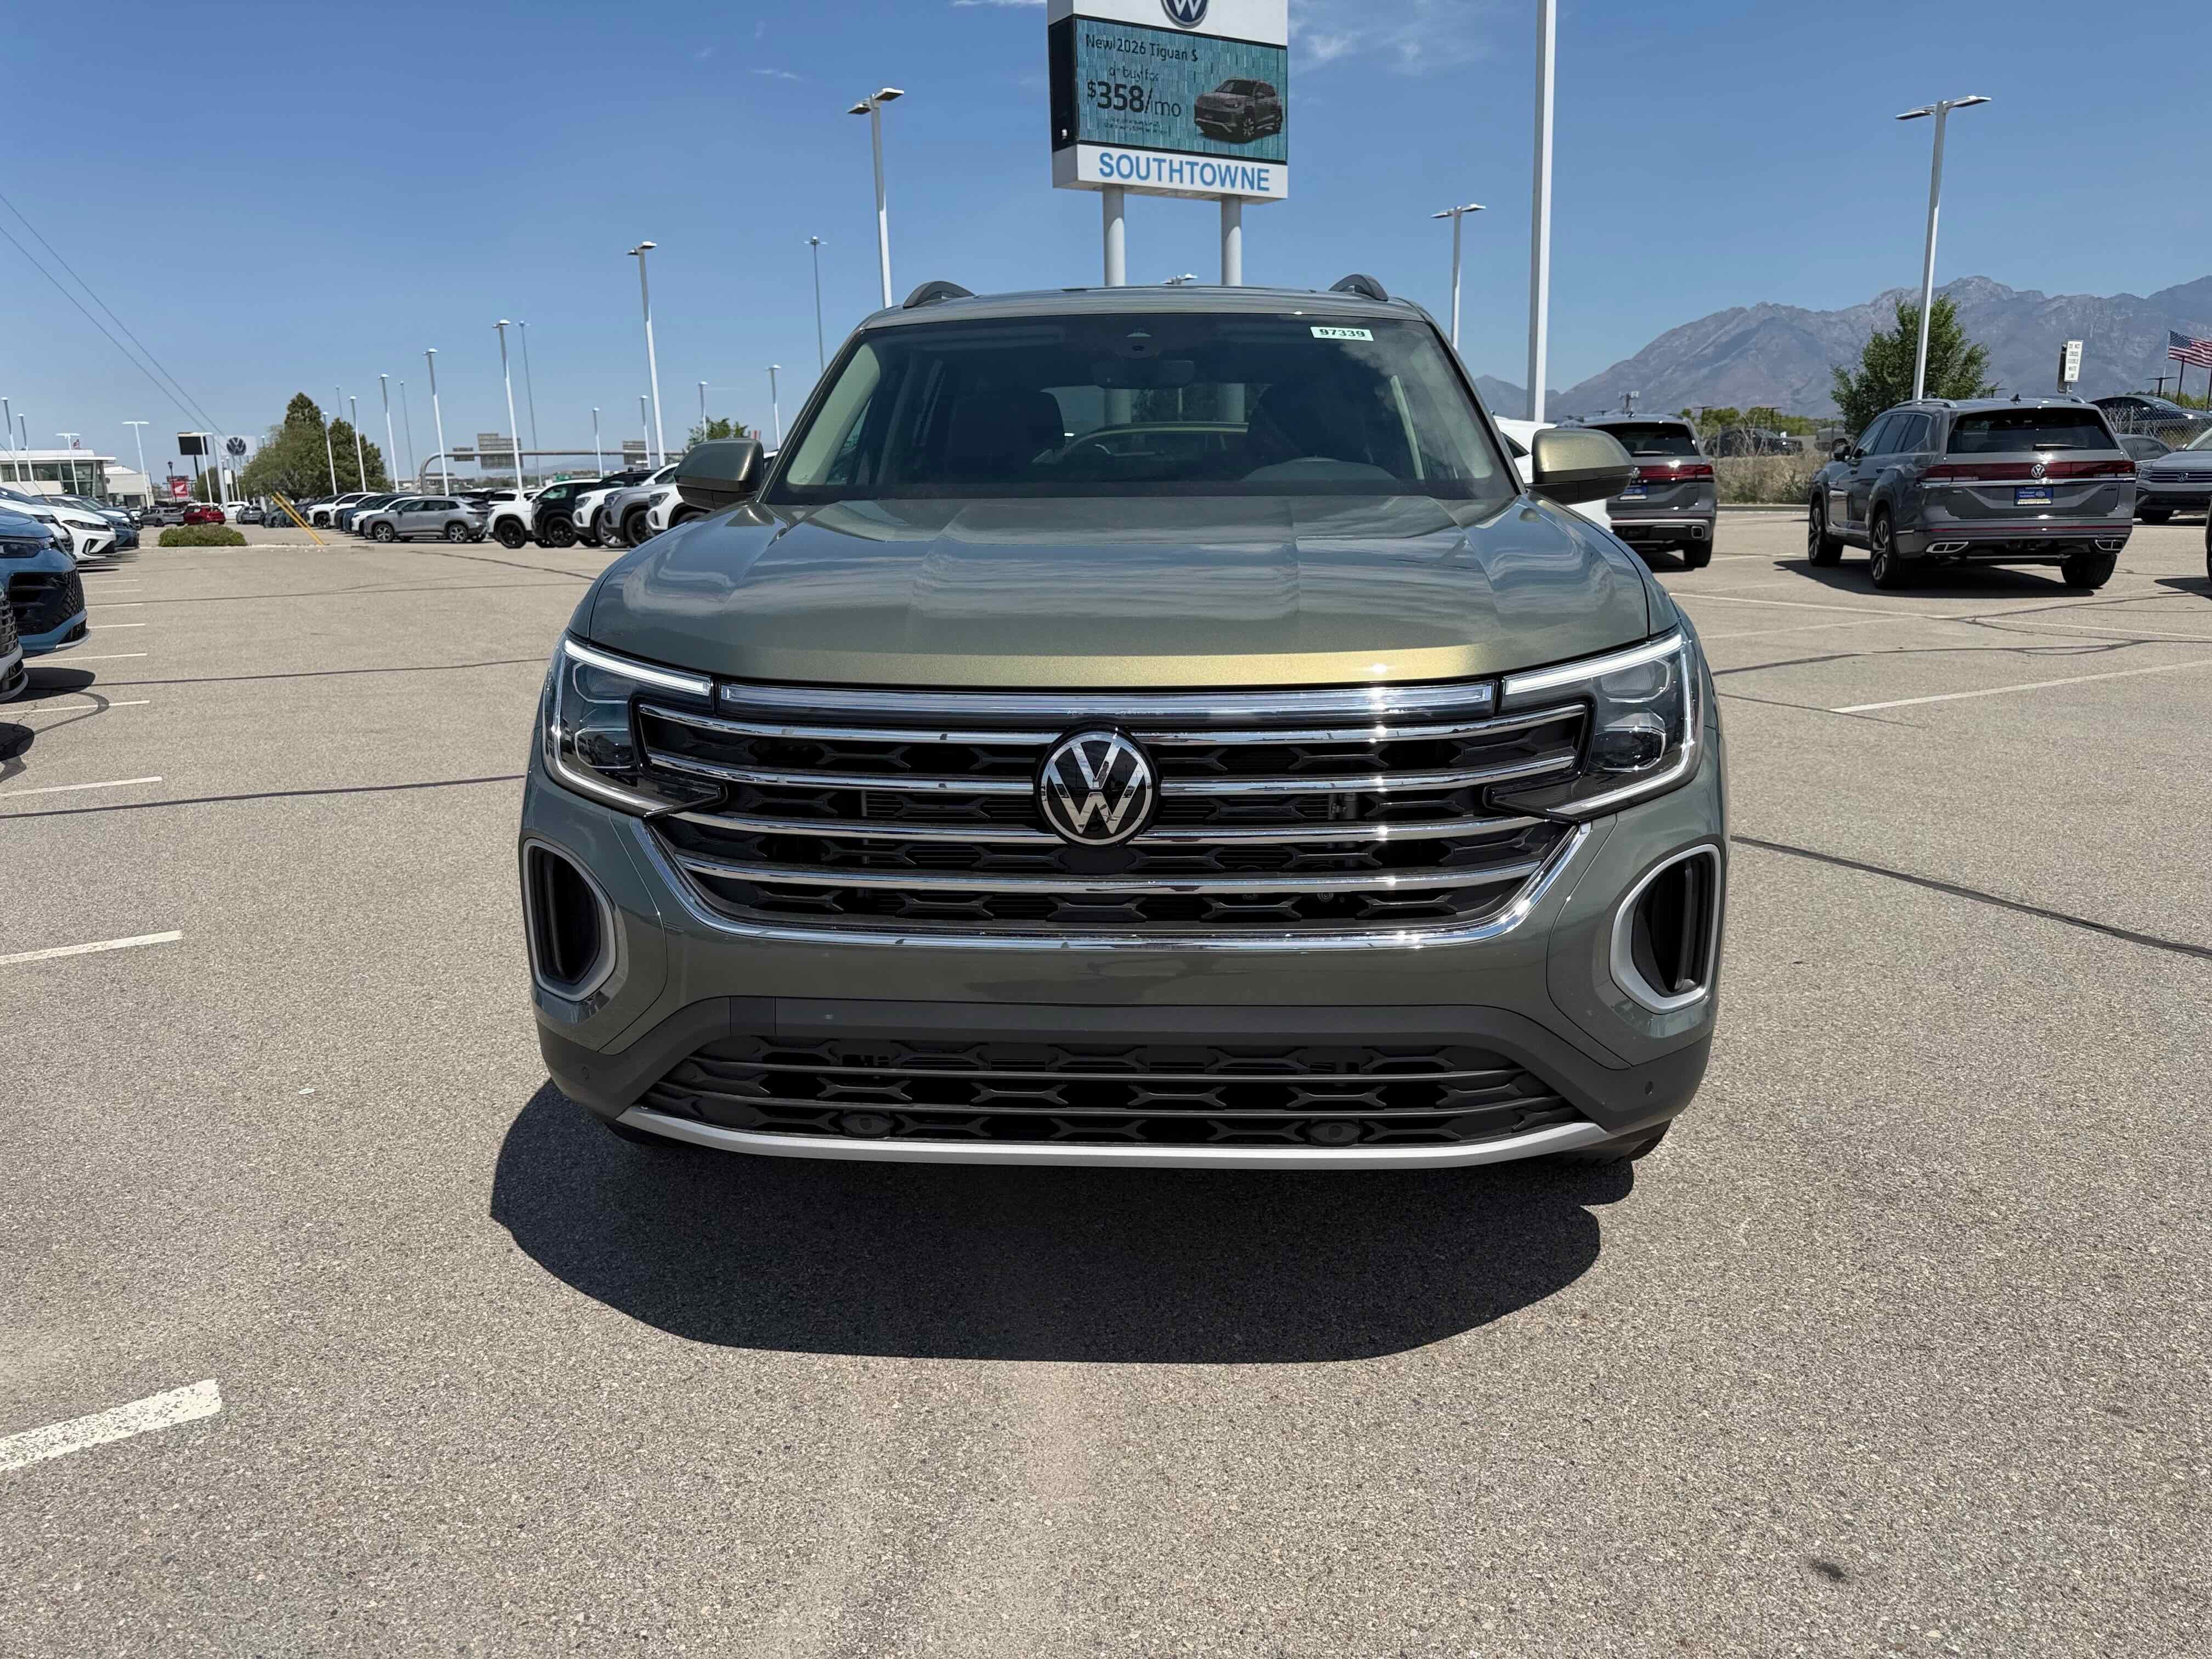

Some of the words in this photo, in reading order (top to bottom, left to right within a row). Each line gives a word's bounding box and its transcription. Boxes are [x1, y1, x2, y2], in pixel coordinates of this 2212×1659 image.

[1086, 34, 1113, 50] New
[1117, 38, 1146, 54] 2026
[1149, 42, 1188, 61] Tiguan
[1099, 152, 1270, 191] SOUTHTOWNE
[1319, 329, 1365, 337] 97339
[2032, 465, 2045, 477] VW
[1045, 738, 1148, 838] VW
